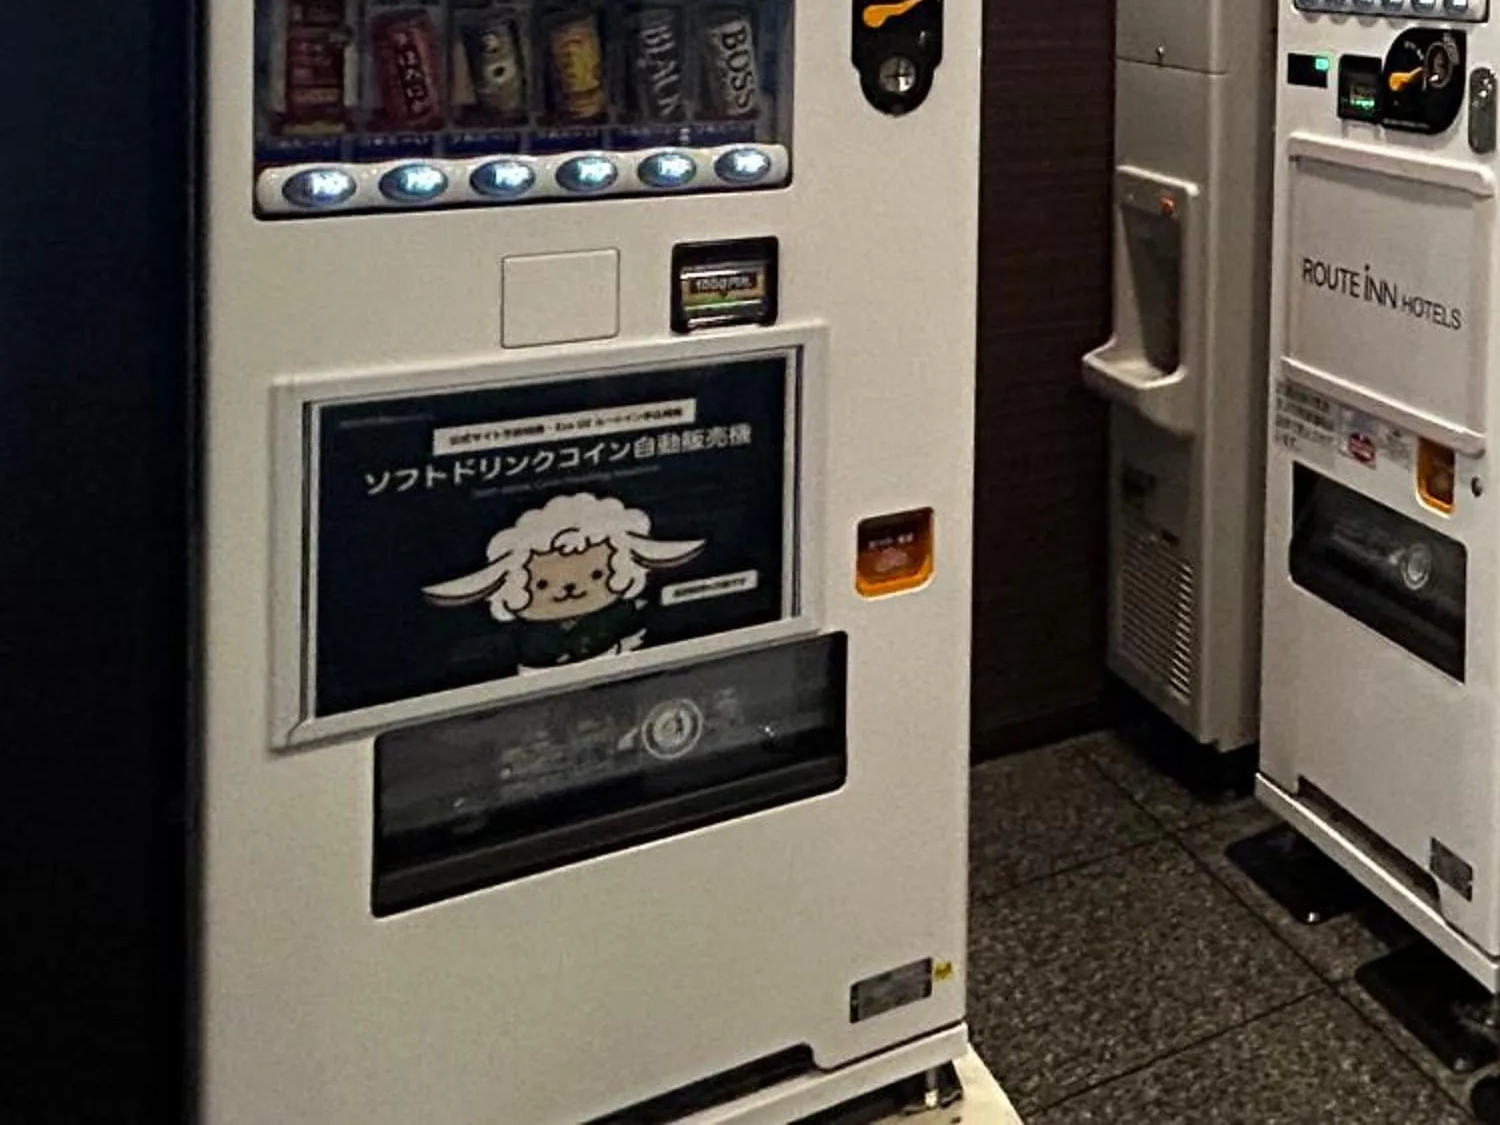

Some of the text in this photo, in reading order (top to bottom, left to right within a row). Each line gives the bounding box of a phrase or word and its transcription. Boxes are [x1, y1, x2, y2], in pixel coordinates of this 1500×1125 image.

[1301, 257, 1361, 299] ROUTE
[1400, 295, 1462, 331] HOTELS
[363, 422, 752, 495] ソフトドリンクコイン自動販売機
